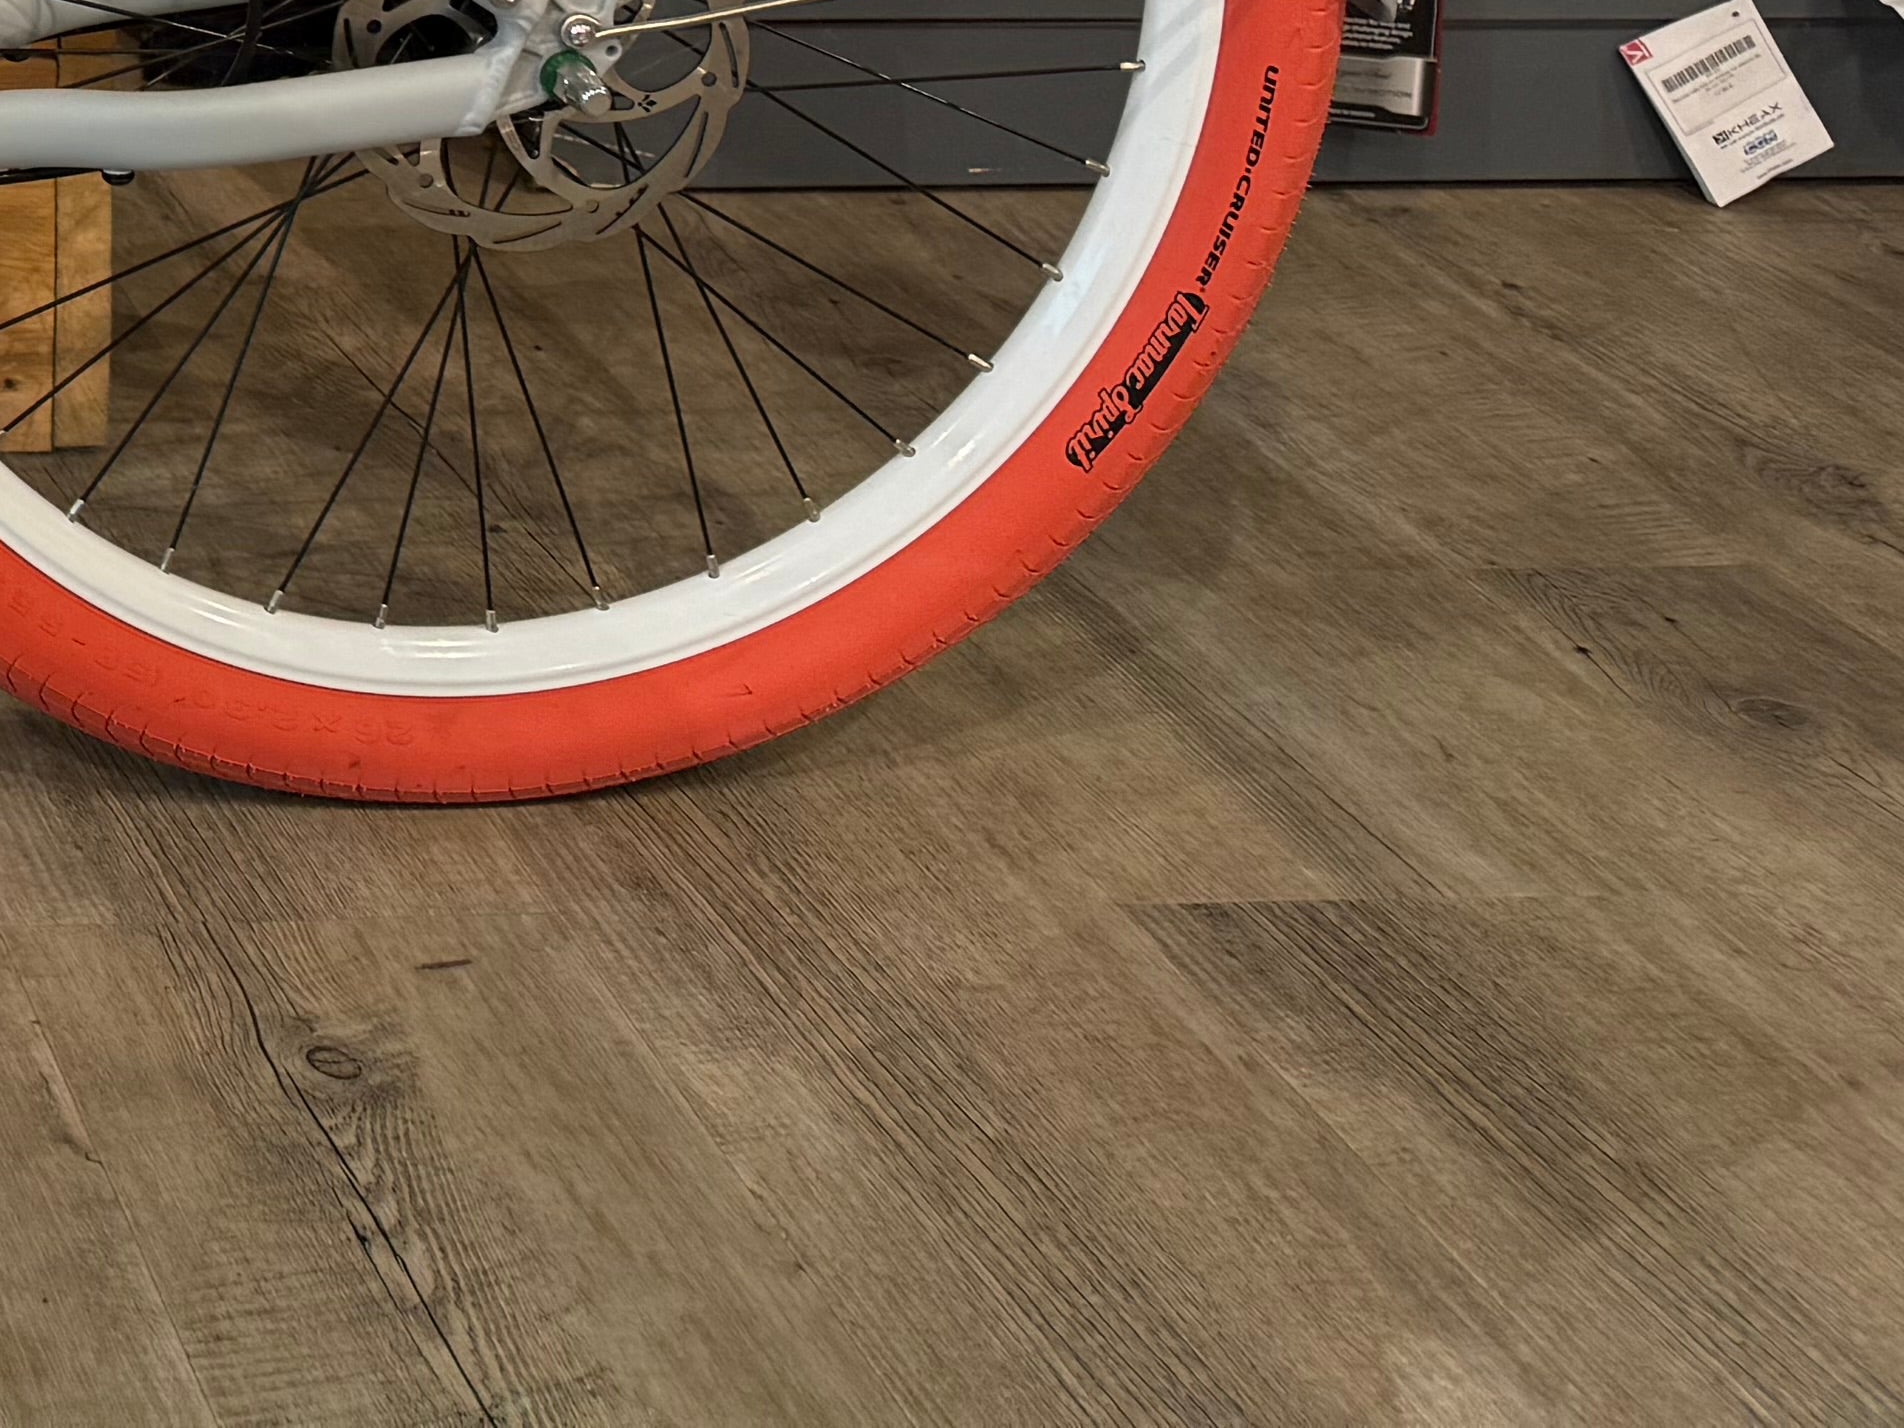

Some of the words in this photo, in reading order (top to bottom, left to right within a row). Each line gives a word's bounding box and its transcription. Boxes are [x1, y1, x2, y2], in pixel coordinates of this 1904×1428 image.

[1726, 101, 1784, 141] KHEAX
[1126, 290, 1211, 392] Tarmac
[1065, 384, 1142, 474] Spirit
